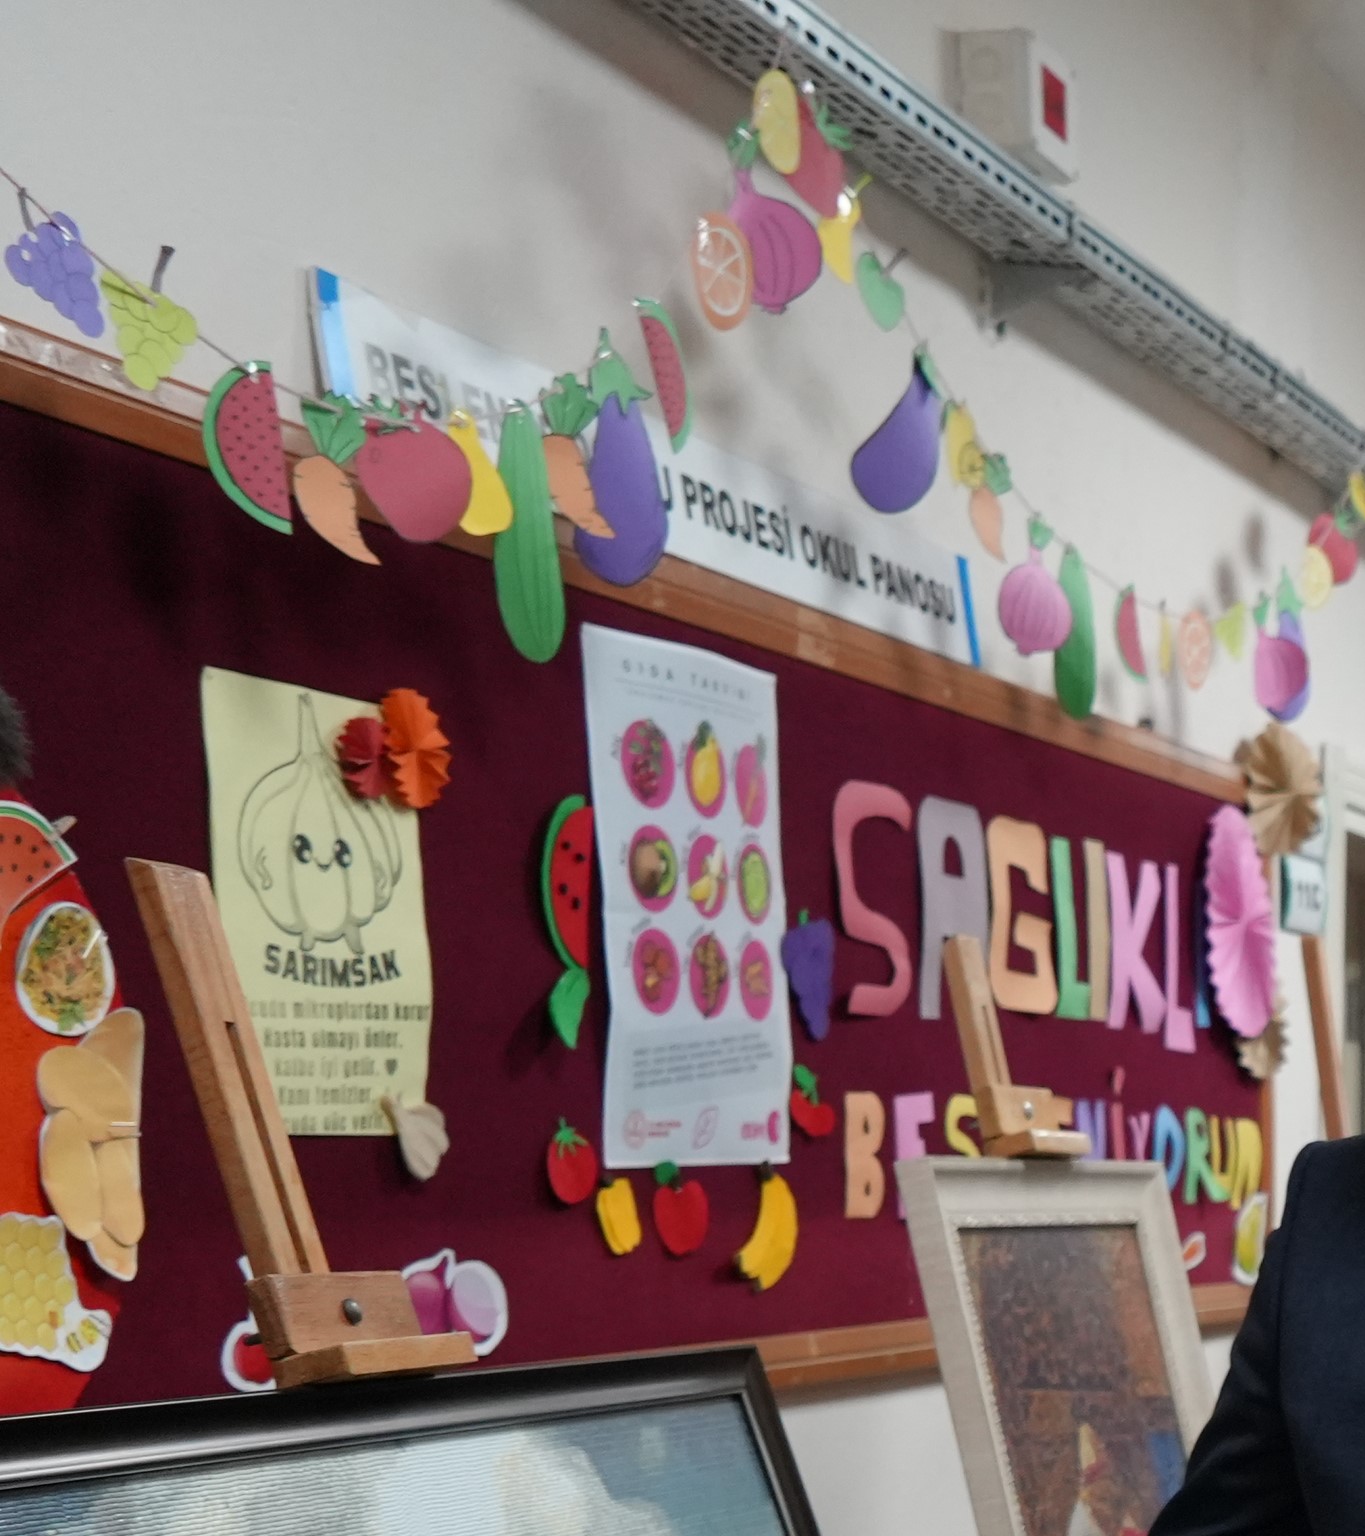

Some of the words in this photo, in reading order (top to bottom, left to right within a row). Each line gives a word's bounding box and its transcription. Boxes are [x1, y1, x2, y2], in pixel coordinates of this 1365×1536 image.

[681, 474, 796, 560] PROJESİ
[801, 525, 867, 588] OKUL
[870, 553, 956, 624] PANOSU
[264, 942, 402, 988] SARIMSAK
[832, 778, 1211, 1054] SAGLIKL
[844, 1065, 1264, 1222] BESNİYORUM
